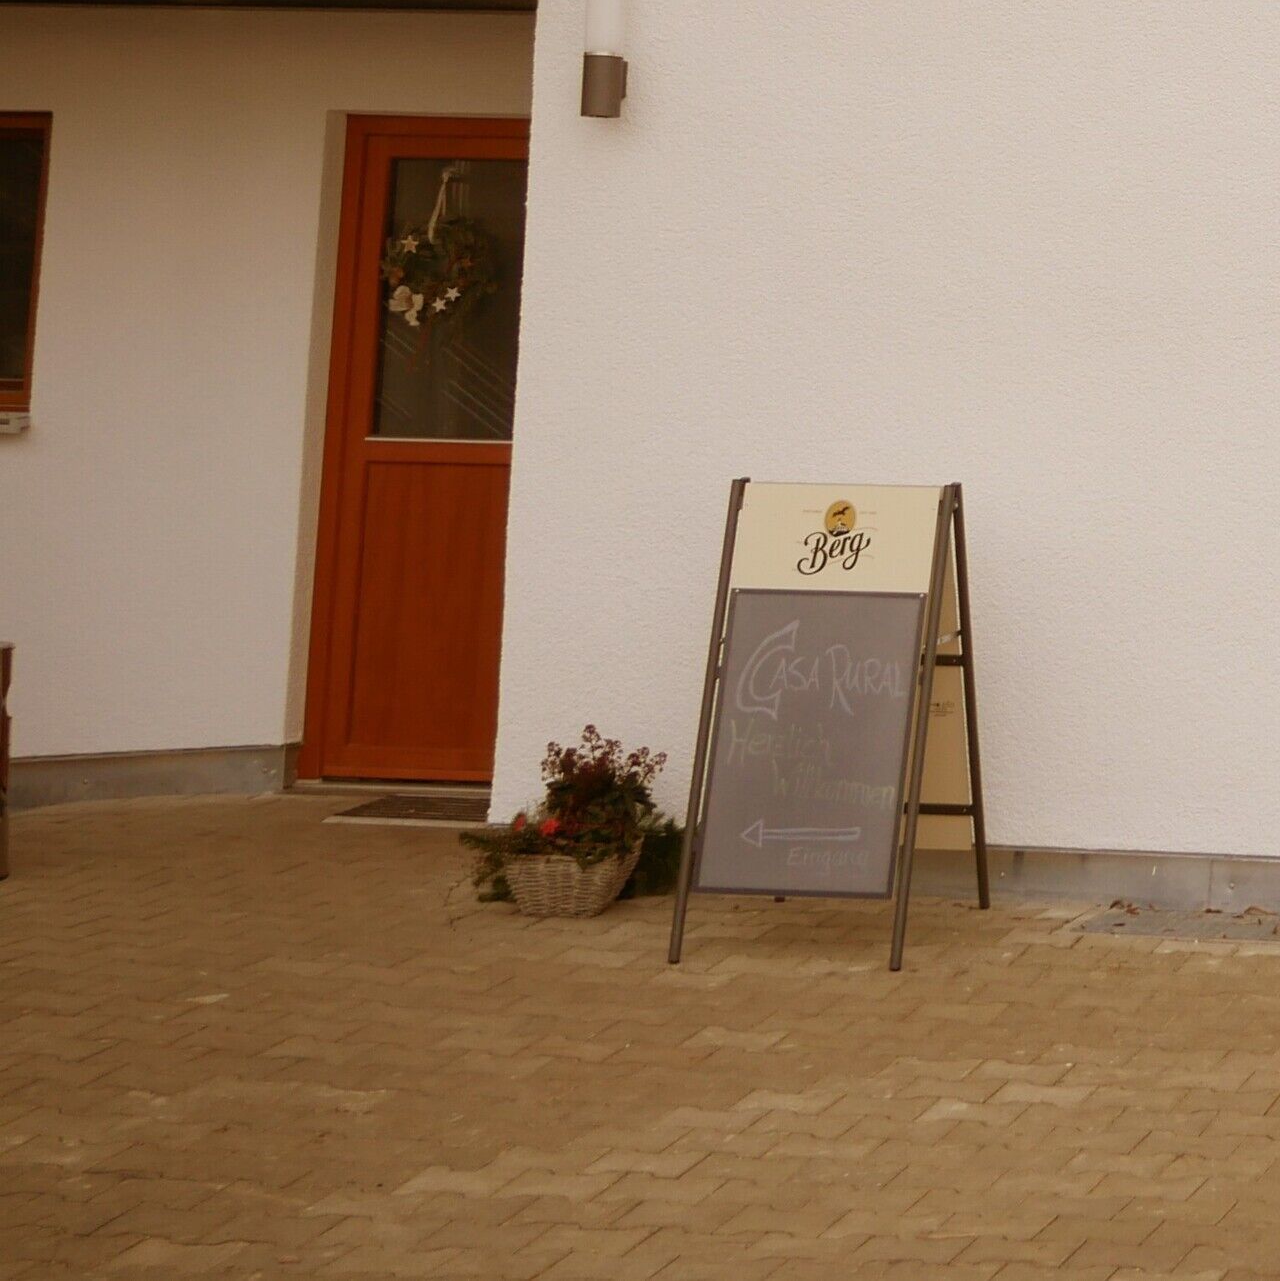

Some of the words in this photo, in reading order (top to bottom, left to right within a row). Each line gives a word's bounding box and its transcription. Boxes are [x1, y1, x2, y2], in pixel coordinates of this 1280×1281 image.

[796, 531, 872, 576] Berg
[735, 618, 820, 721] CASA
[825, 643, 908, 717] RURAL
